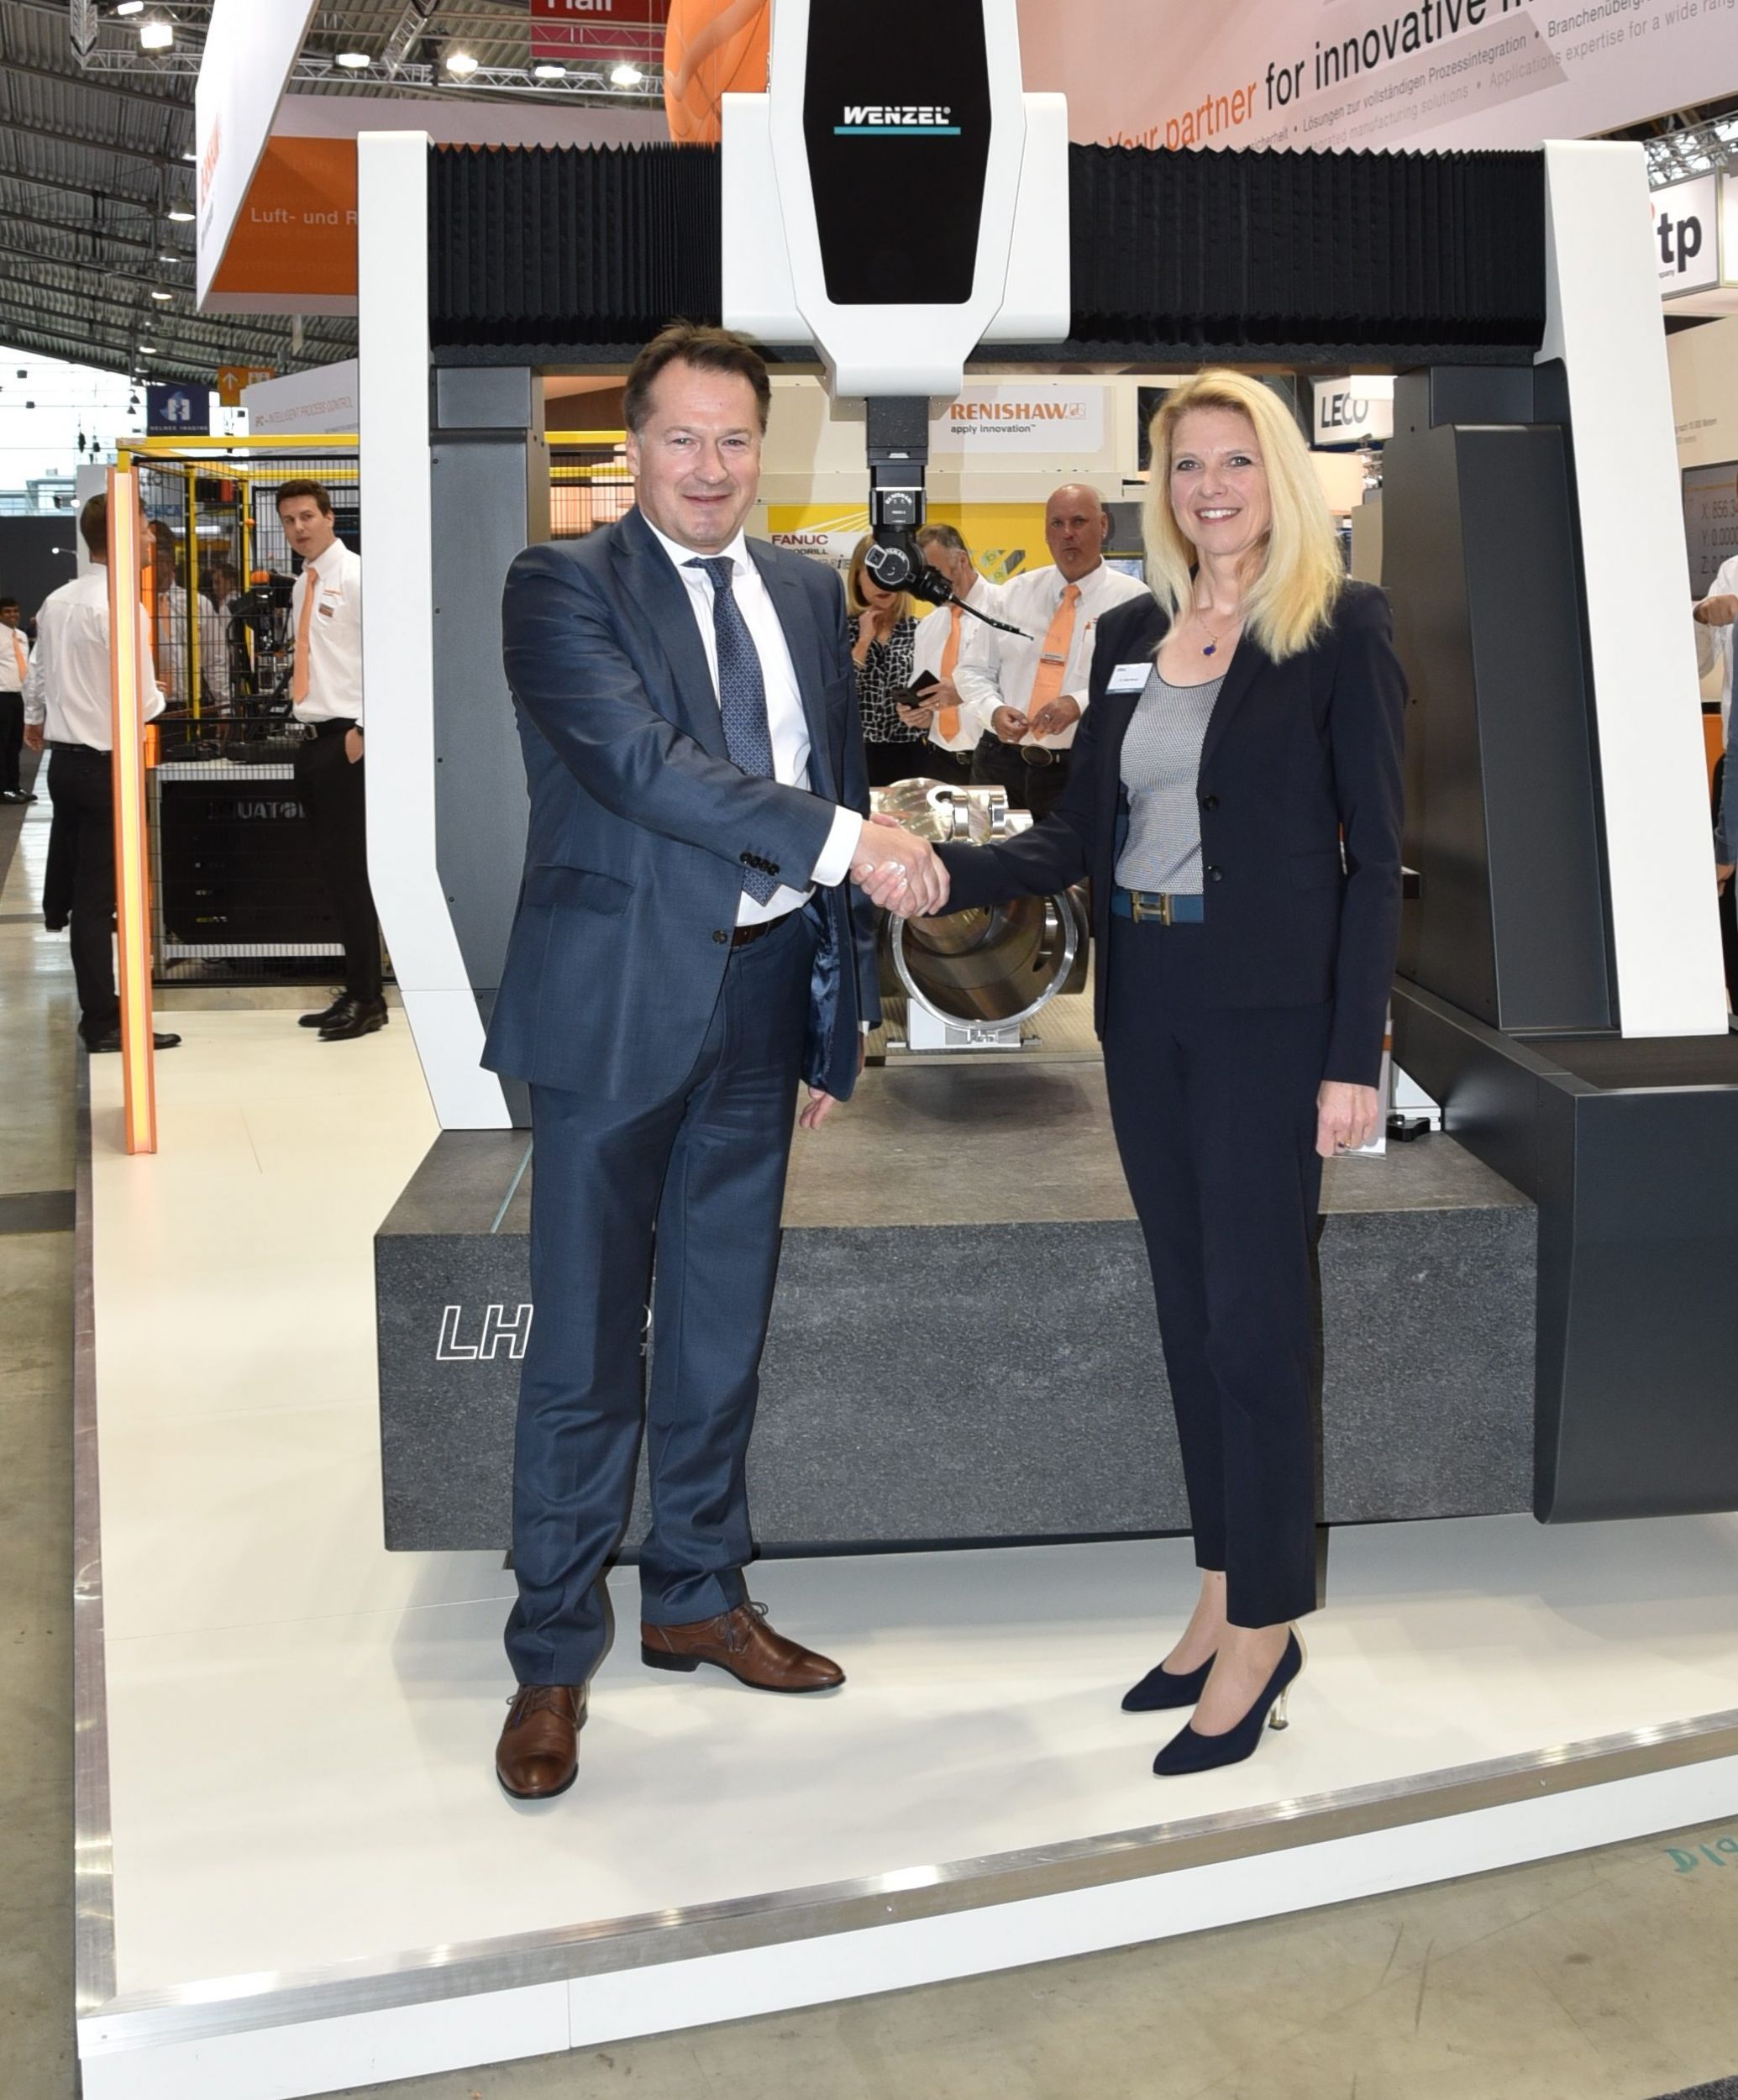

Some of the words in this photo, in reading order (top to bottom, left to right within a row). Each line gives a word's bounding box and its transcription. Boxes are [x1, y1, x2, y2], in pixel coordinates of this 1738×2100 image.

[1303, 106, 1344, 133] Lösungen
[1363, 74, 1426, 109] vollständigen
[1429, 35, 1527, 83] Prozessintegration
[1547, 0, 1645, 37] Branchenüberg
[1420, 85, 1469, 113] solutions
[1489, 51, 1562, 89] Applications
[1566, 28, 1625, 62] expertise
[1629, 19, 1647, 39] for
[1652, 16, 1660, 30] a
[1665, 1, 1698, 26] wide
[1703, 0, 1735, 13] rang
[1166, 82, 1258, 152] partner
[1265, 60, 1305, 110] for
[1315, 0, 1486, 90] innovative
[251, 208, 297, 224] Luft-
[303, 211, 339, 225] und
[346, 212, 359, 225] R
[950, 402, 1069, 420] RENISHAW
[1321, 392, 1369, 428] LECO
[950, 424, 978, 435] apply
[771, 534, 828, 545] FANUC
[436, 1304, 533, 1360] LH
